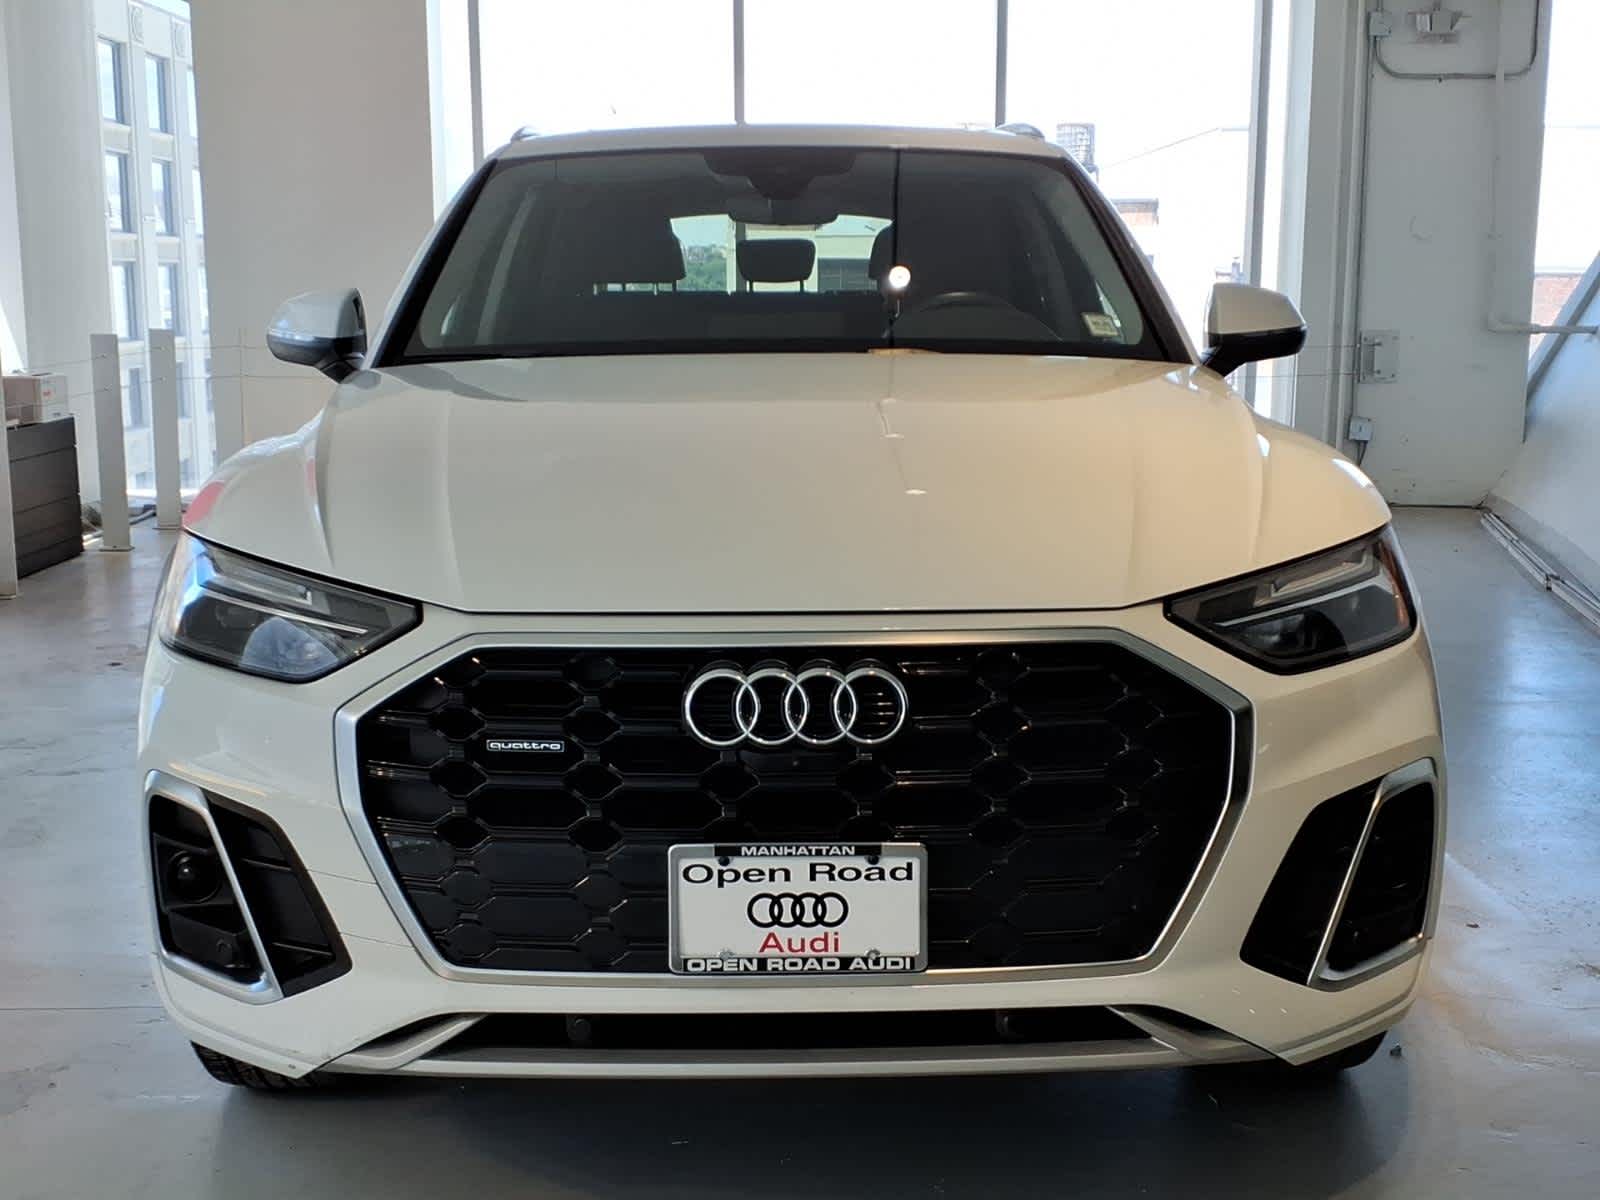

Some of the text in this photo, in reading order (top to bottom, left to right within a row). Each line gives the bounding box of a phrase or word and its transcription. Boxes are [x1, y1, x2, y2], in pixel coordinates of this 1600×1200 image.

[489, 742, 561, 751] quattro
[741, 846, 856, 857] MANHATTAN
[682, 862, 913, 888] Open Road
[758, 931, 840, 953] Audi
[686, 956, 911, 972] OPEN ROAD AUDI
